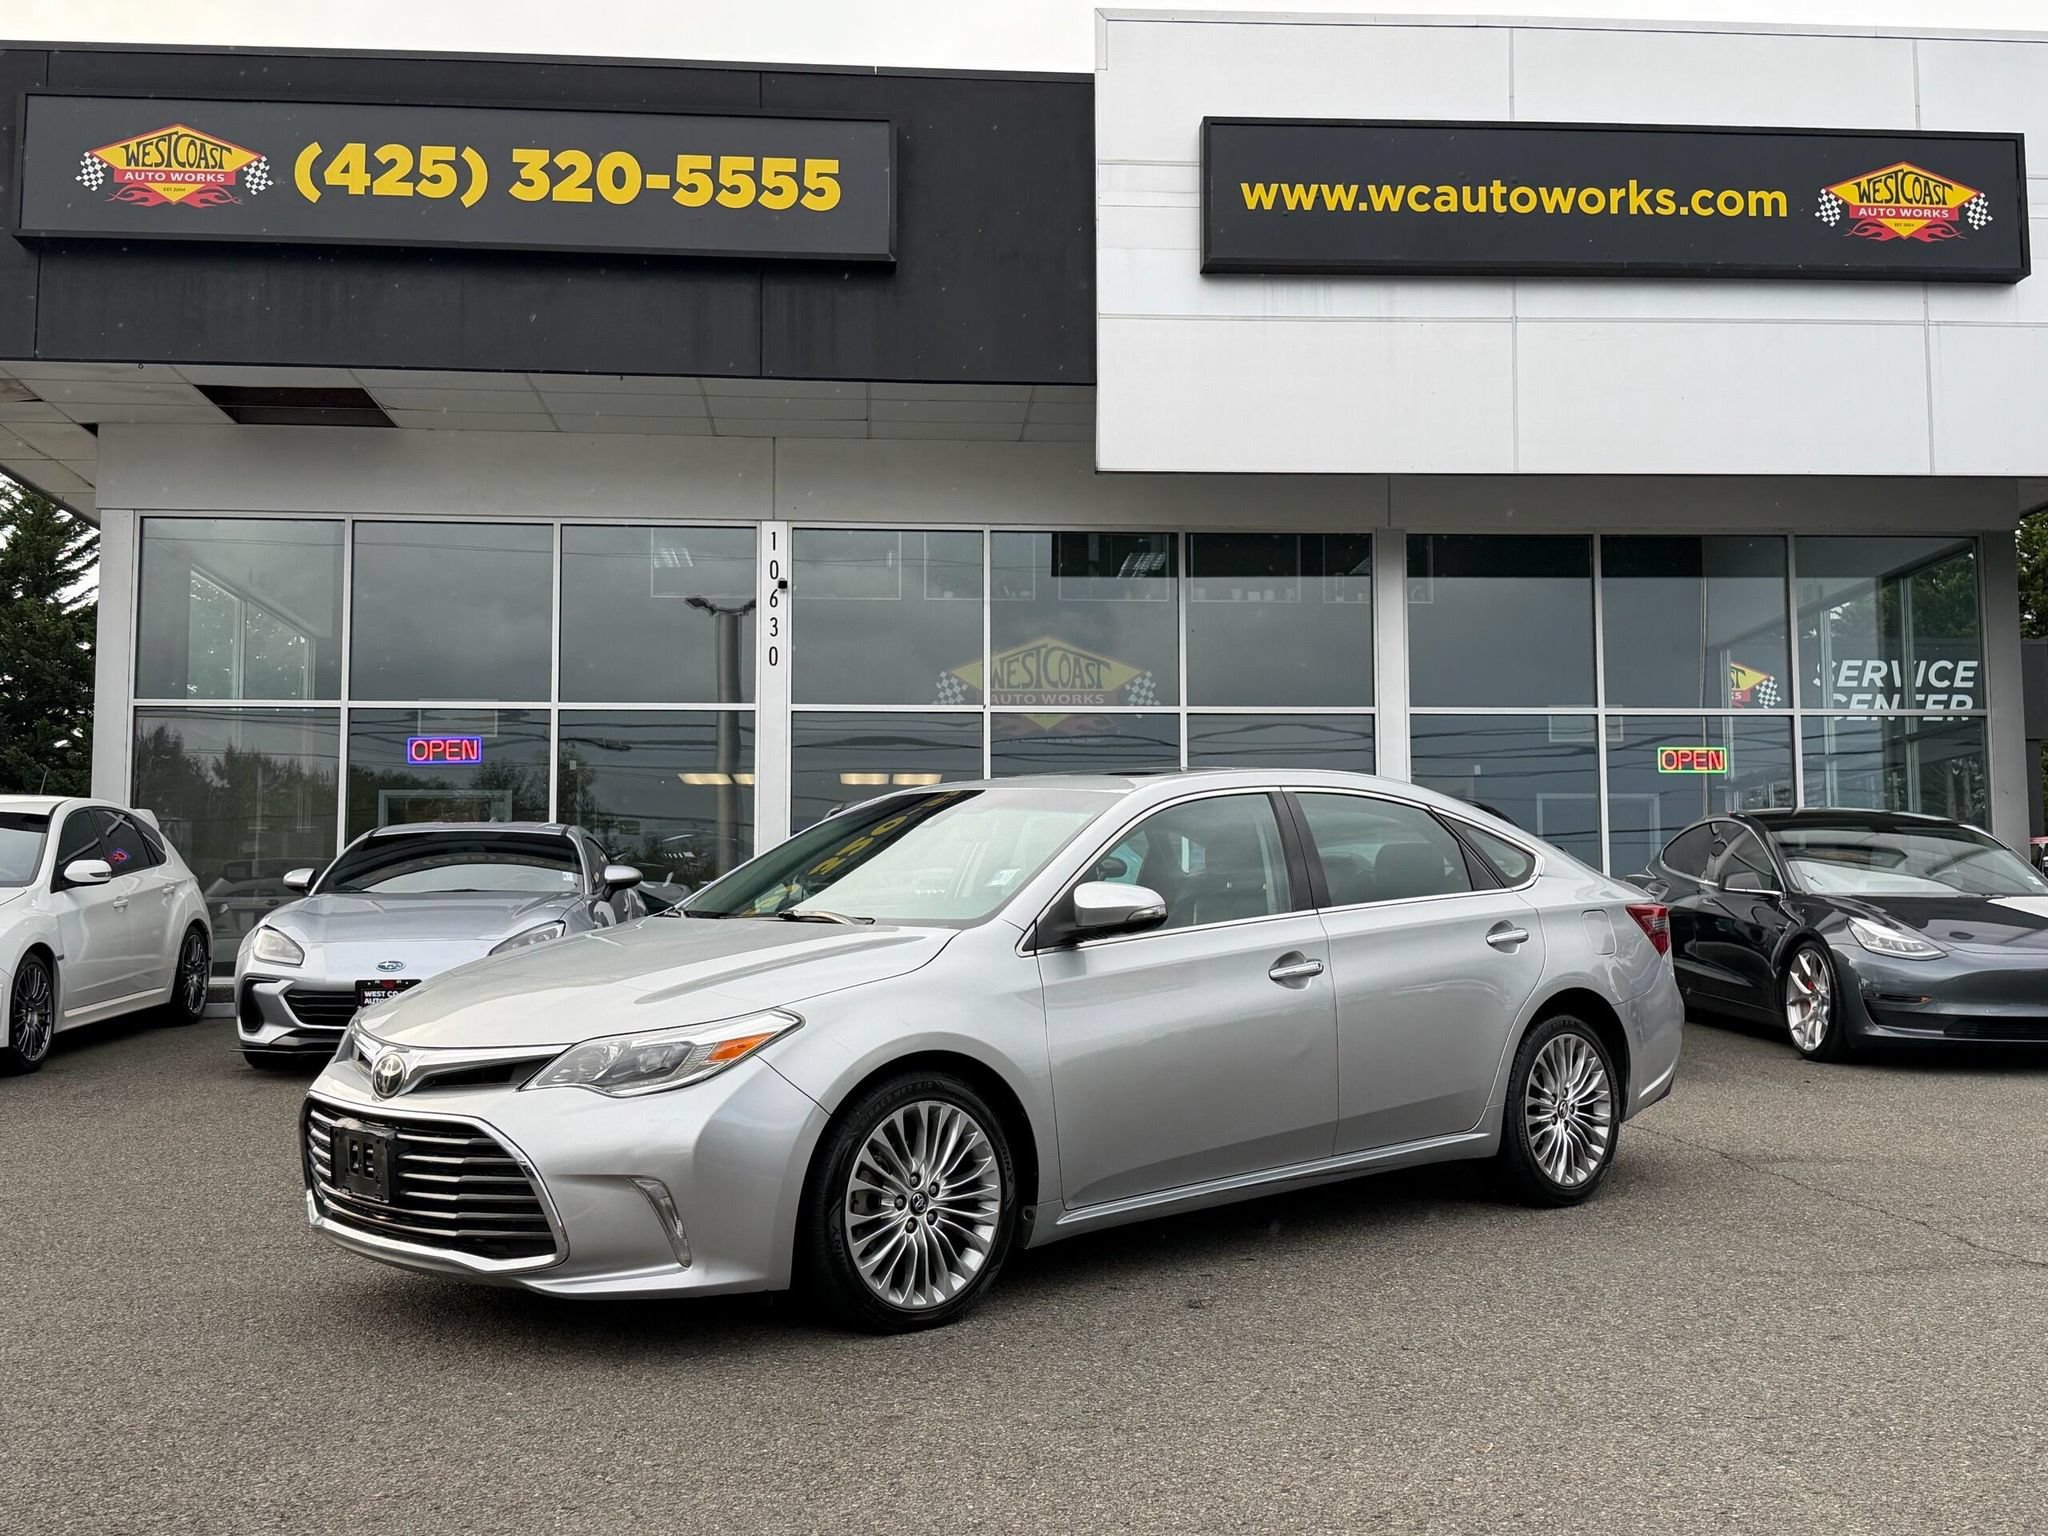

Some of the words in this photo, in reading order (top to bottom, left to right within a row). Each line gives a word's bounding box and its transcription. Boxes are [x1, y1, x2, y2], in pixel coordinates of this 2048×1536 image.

[124, 171, 166, 182] AUTO
[170, 172, 225, 183] WORKS
[294, 141, 489, 209] (425)
[508, 148, 841, 211] 320-5555
[1240, 179, 1788, 217] www.wcautoworks.com
[1858, 207, 1896, 217] AUTO
[1900, 208, 1949, 219] WORKS
[769, 531, 779, 666] 10630
[990, 693, 1037, 705] AUTO
[1040, 693, 1105, 705] WORKS
[411, 739, 478, 761] OPEN
[1661, 750, 1724, 770] OPEN
[364, 990, 385, 998] WEST
